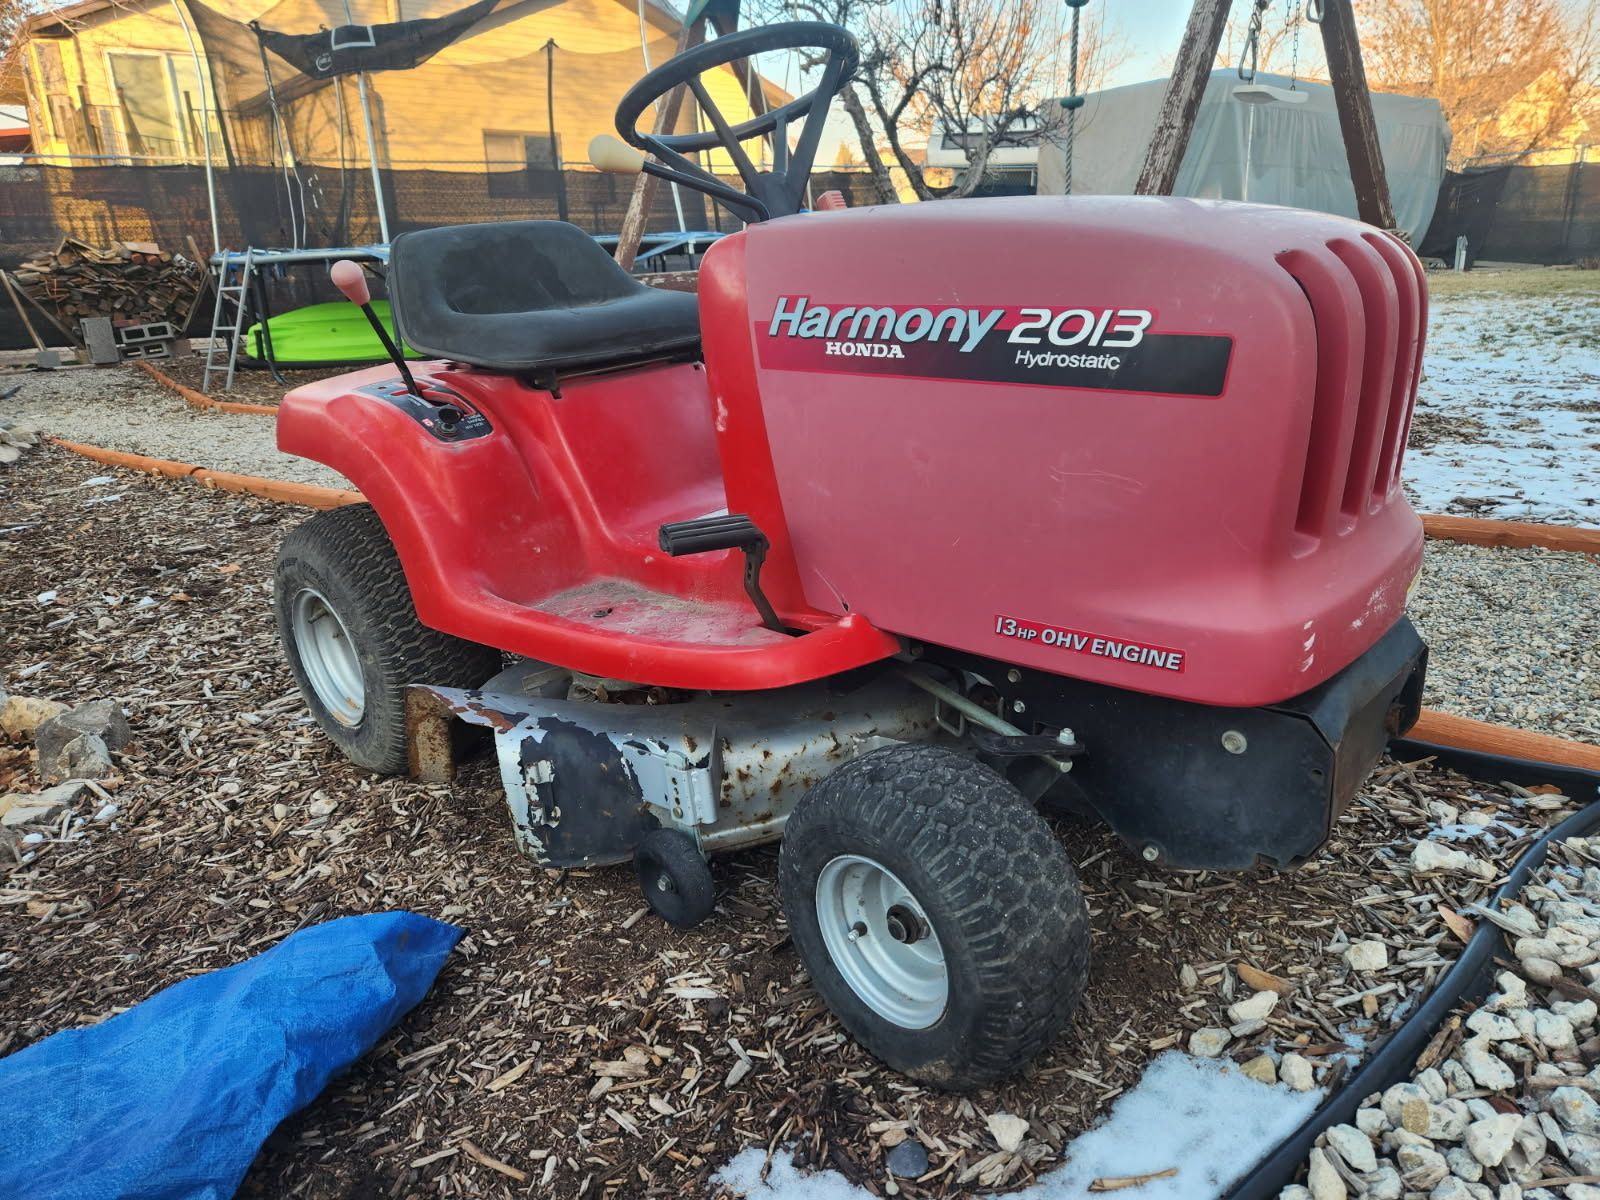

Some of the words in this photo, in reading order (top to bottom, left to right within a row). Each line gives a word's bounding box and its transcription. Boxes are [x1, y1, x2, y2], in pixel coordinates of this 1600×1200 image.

[769, 297, 1005, 353] Harmony
[1007, 308, 1152, 348] 2013
[825, 341, 905, 359] HONDA
[1015, 350, 1121, 371] Hydrostatic
[1041, 628, 1088, 651] OHV
[1091, 639, 1183, 671] ENGINE
